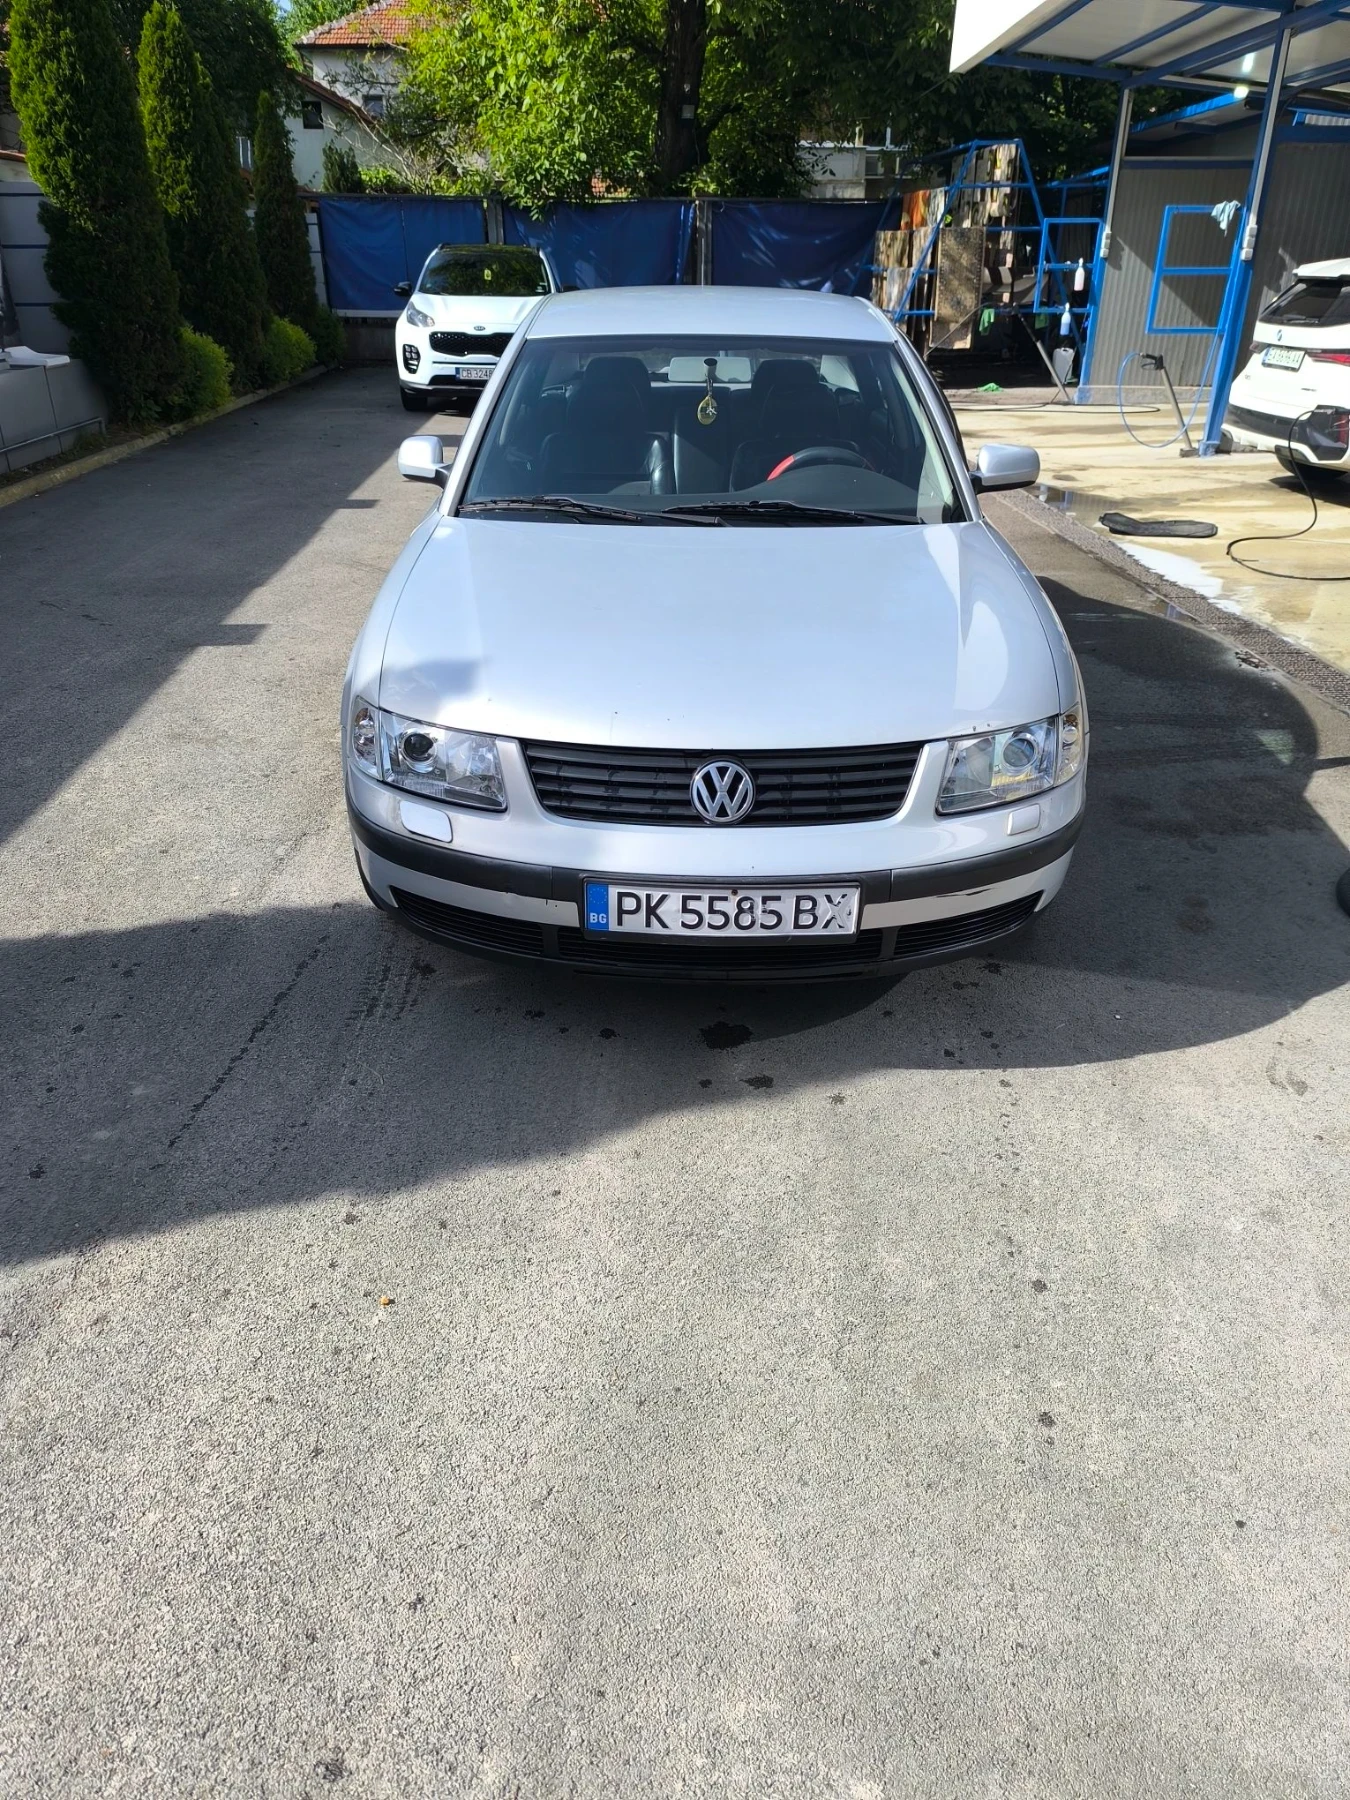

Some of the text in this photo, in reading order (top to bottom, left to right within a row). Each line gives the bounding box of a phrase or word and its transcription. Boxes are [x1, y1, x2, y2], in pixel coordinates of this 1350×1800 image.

[461, 369, 472, 378] CB
[616, 891, 848, 931] PK 5585 BX
[589, 913, 607, 924] BG
